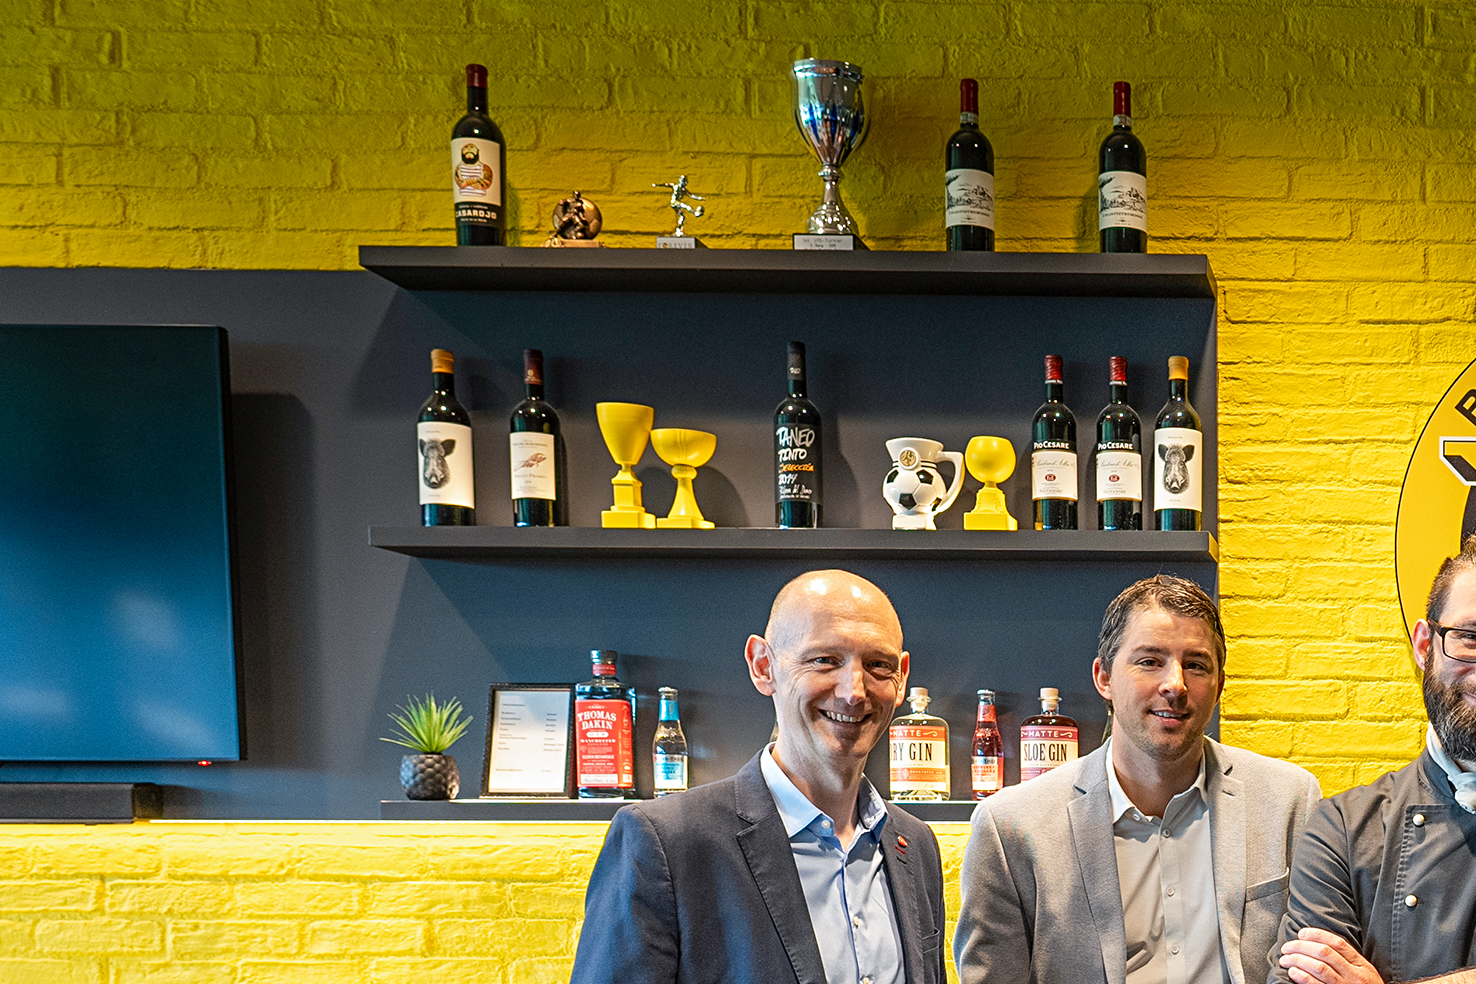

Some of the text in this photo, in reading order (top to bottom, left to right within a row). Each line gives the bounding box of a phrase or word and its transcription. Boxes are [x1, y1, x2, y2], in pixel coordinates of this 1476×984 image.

[776, 426, 815, 447] TANEO
[778, 448, 807, 462] TINTO
[577, 710, 617, 722] THOMAS
[582, 719, 613, 730] DAKIN
[893, 729, 922, 737] MATTE
[909, 742, 932, 761] GIN
[1023, 743, 1067, 762] SLOE GIN
